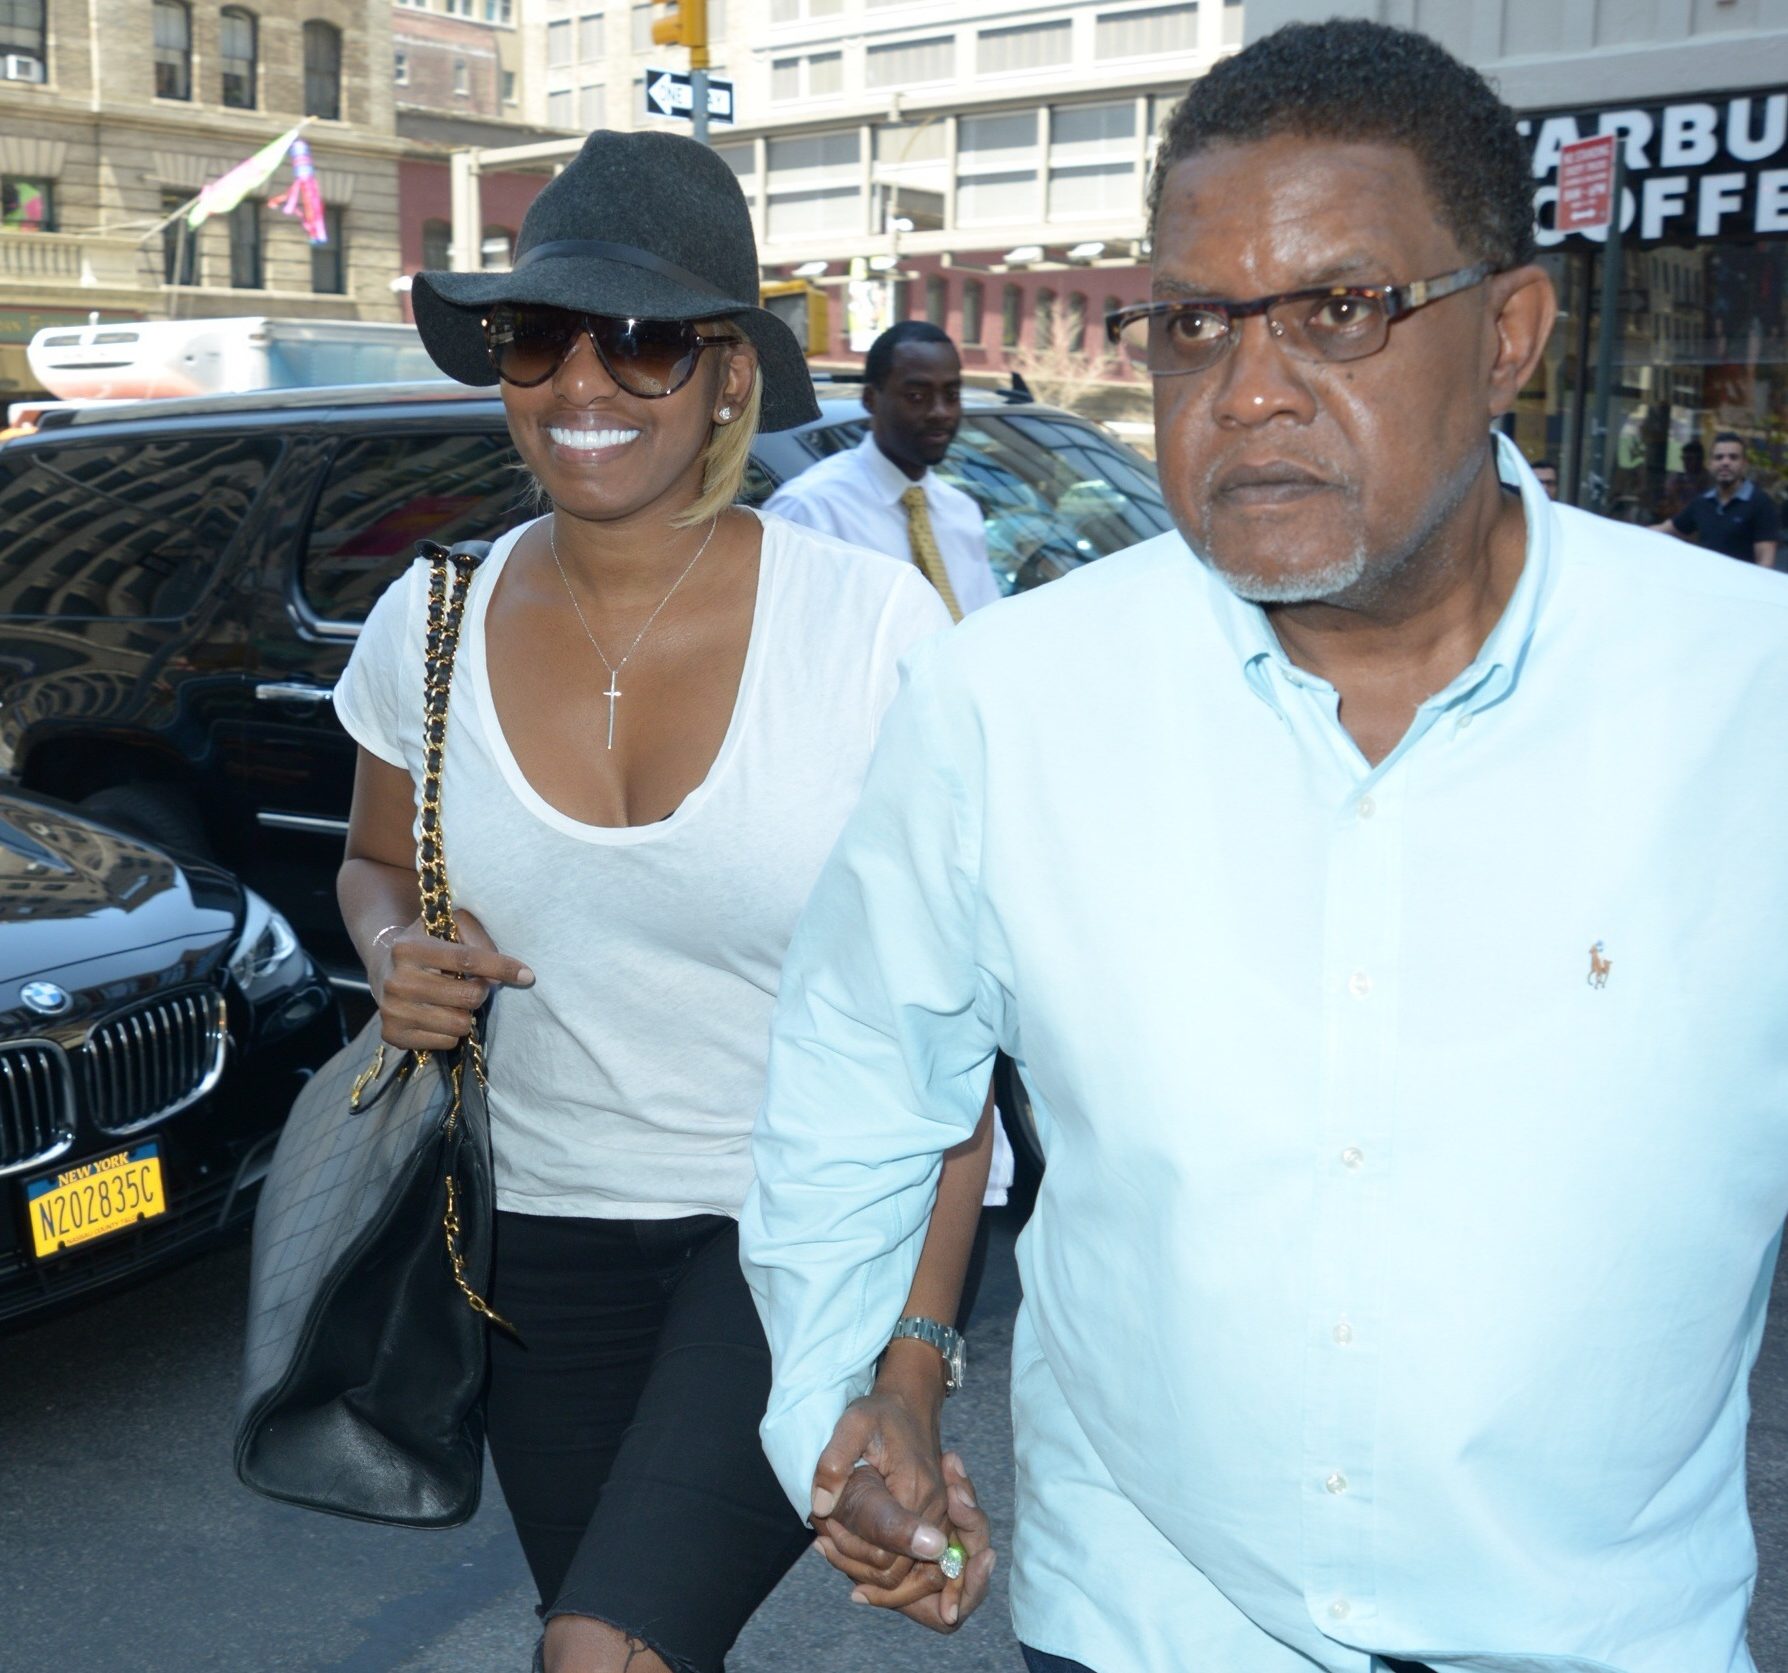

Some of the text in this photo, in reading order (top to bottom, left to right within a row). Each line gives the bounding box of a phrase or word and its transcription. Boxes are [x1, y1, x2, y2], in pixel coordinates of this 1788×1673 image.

[1515, 93, 1788, 179] ARBU
[39, 1165, 154, 1241] N202835C
[57, 1151, 129, 1187] NEW YORK
